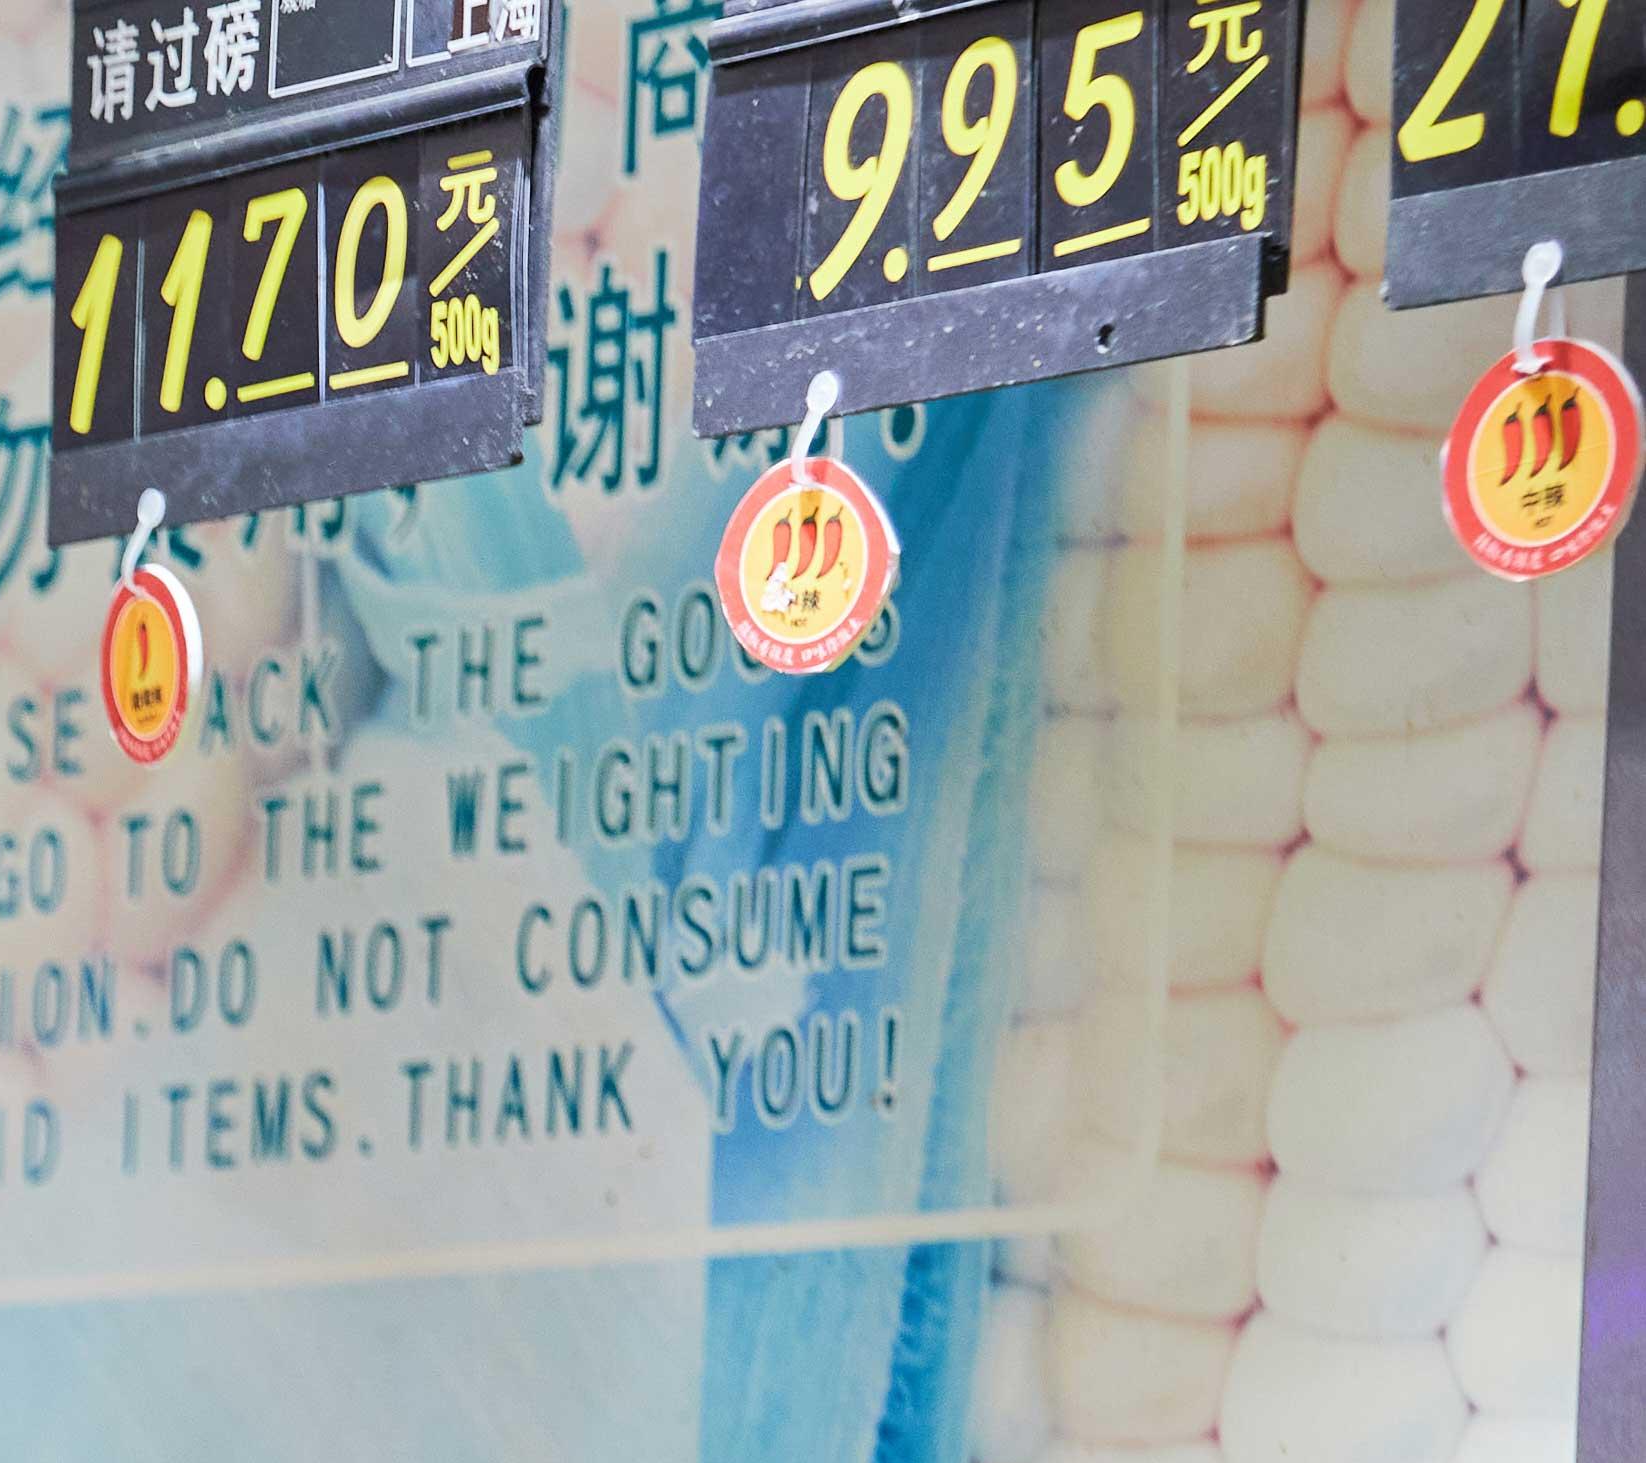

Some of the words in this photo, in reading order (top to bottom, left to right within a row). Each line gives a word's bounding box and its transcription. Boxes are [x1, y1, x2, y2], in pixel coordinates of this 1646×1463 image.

[87, 0, 262, 124] 请过磅
[807, 9, 1147, 302] 9.95
[1176, 140, 1268, 232] 500g
[69, 174, 409, 436] 11.70
[430, 294, 501, 376] 500g
[199, 654, 339, 757] ACK
[408, 616, 545, 719] THE
[121, 808, 201, 900] TO
[258, 783, 383, 882] THE
[446, 709, 906, 855] WEIGHTING
[317, 912, 451, 1018] NOT
[516, 864, 883, 994] CONSUME
[709, 1014, 897, 1119] YOU!
